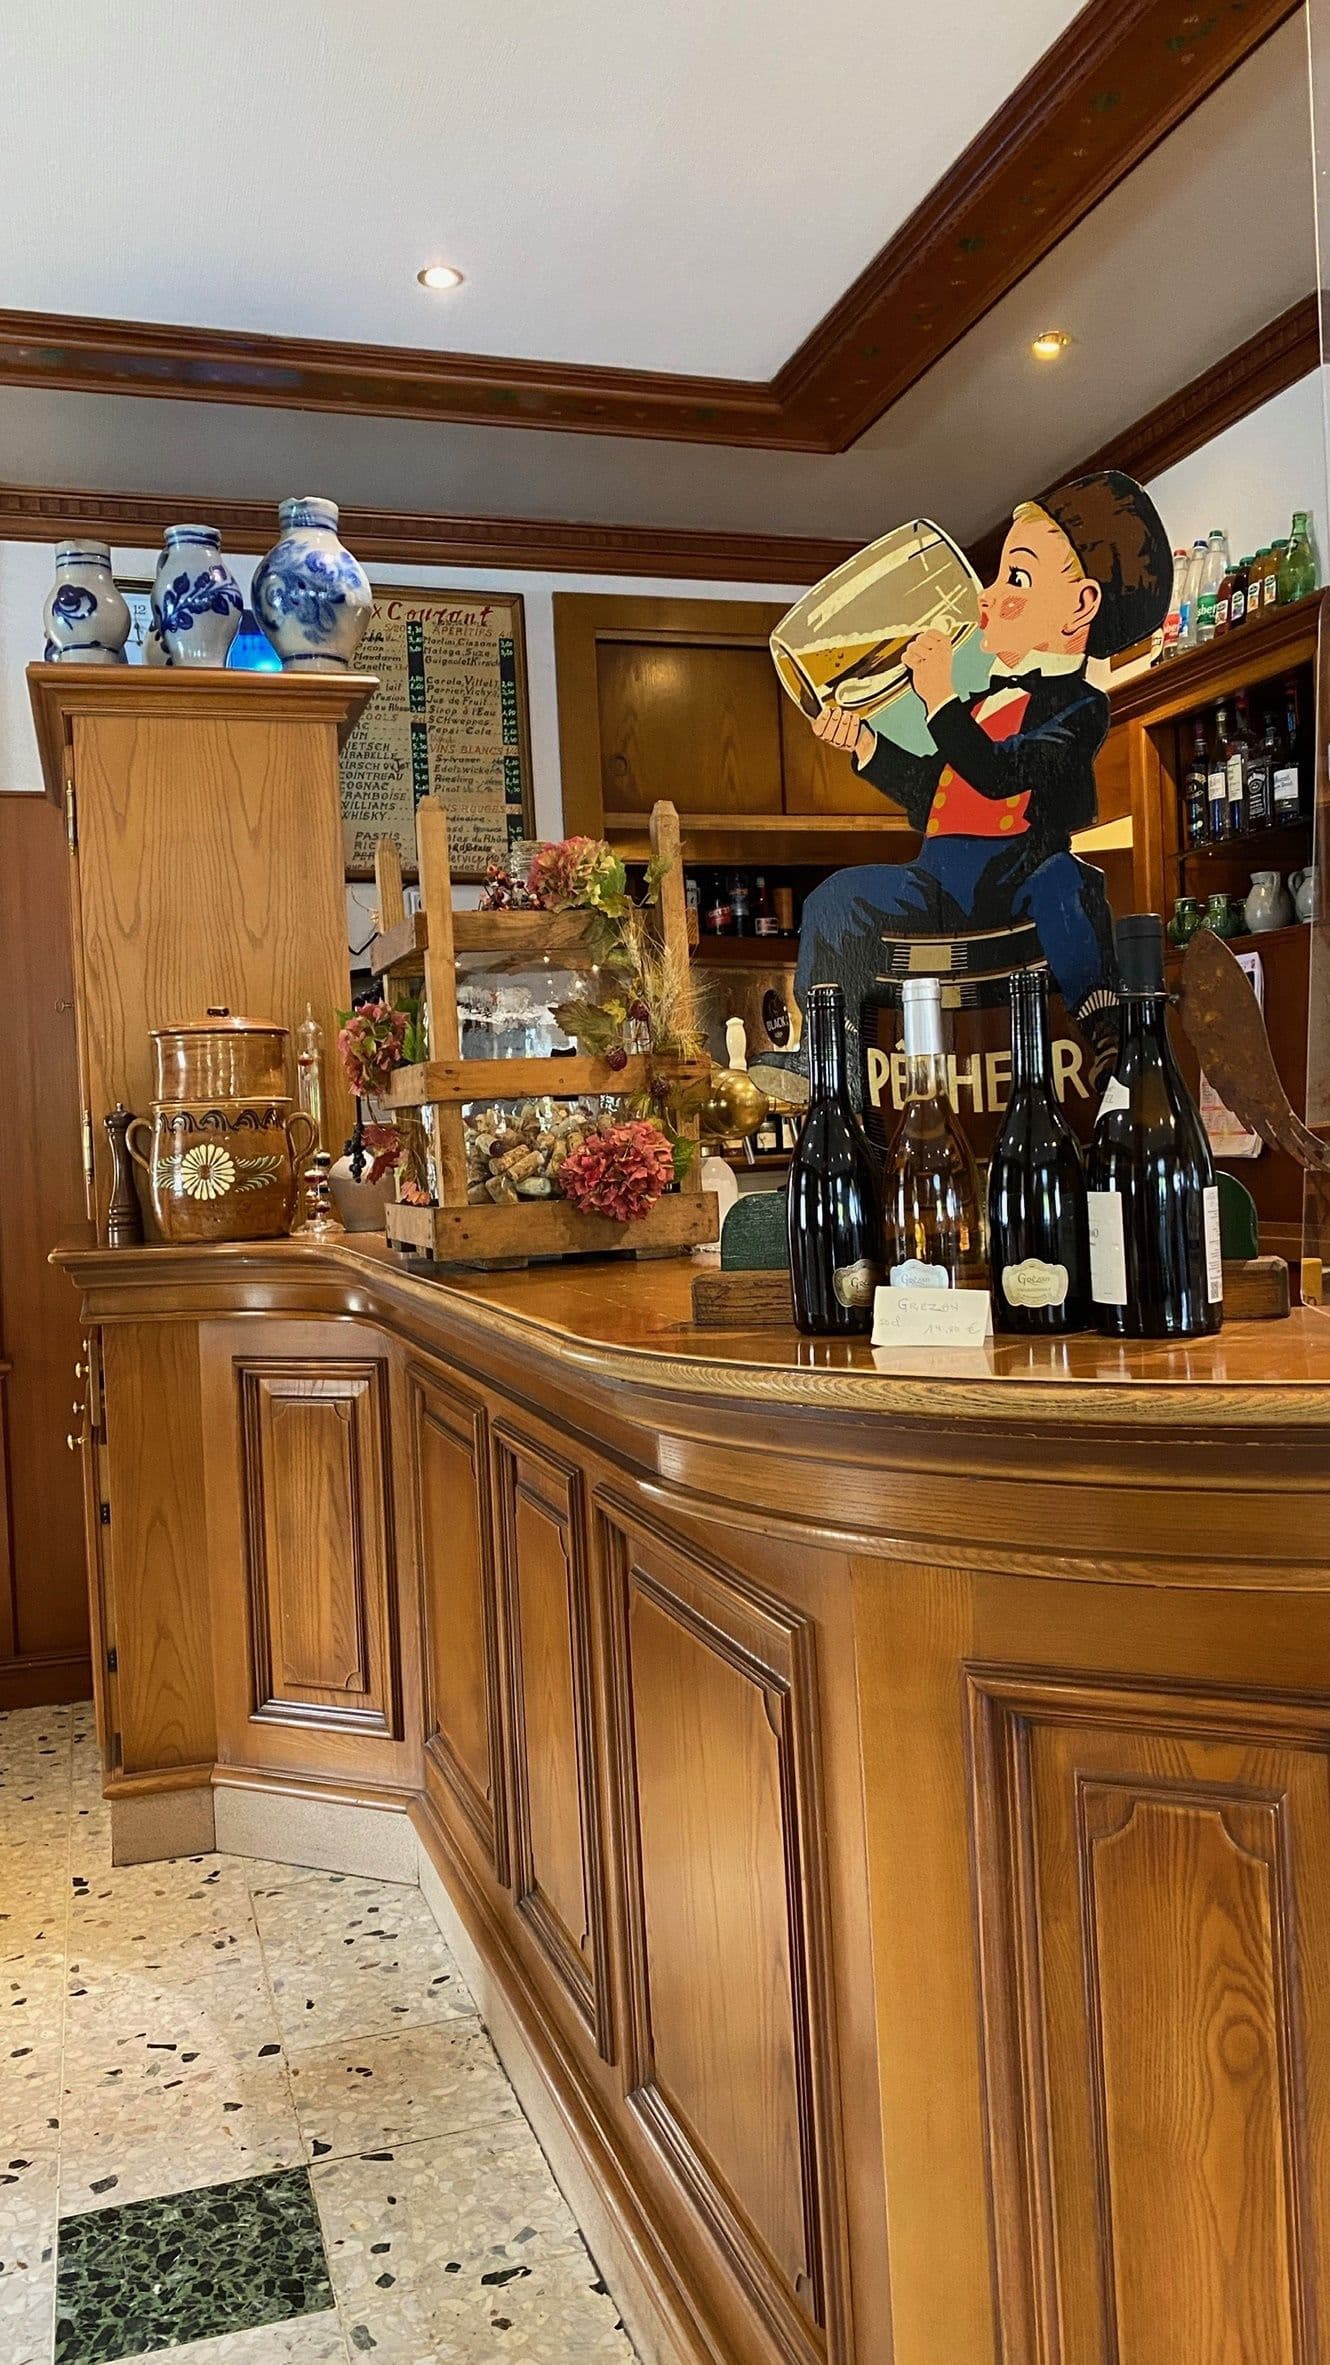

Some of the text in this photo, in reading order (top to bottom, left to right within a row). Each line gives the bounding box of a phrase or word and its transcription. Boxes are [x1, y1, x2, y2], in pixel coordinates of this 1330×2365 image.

[133, 604, 146, 615] 12
[387, 601, 493, 627] Courant
[432, 626, 492, 638] APERITIFS
[462, 696, 487, 706] Fruit
[428, 704, 457, 716] Sirop
[430, 744, 455, 754] VINS
[460, 745, 503, 756] BLANCS
[355, 830, 401, 842] PASTIS
